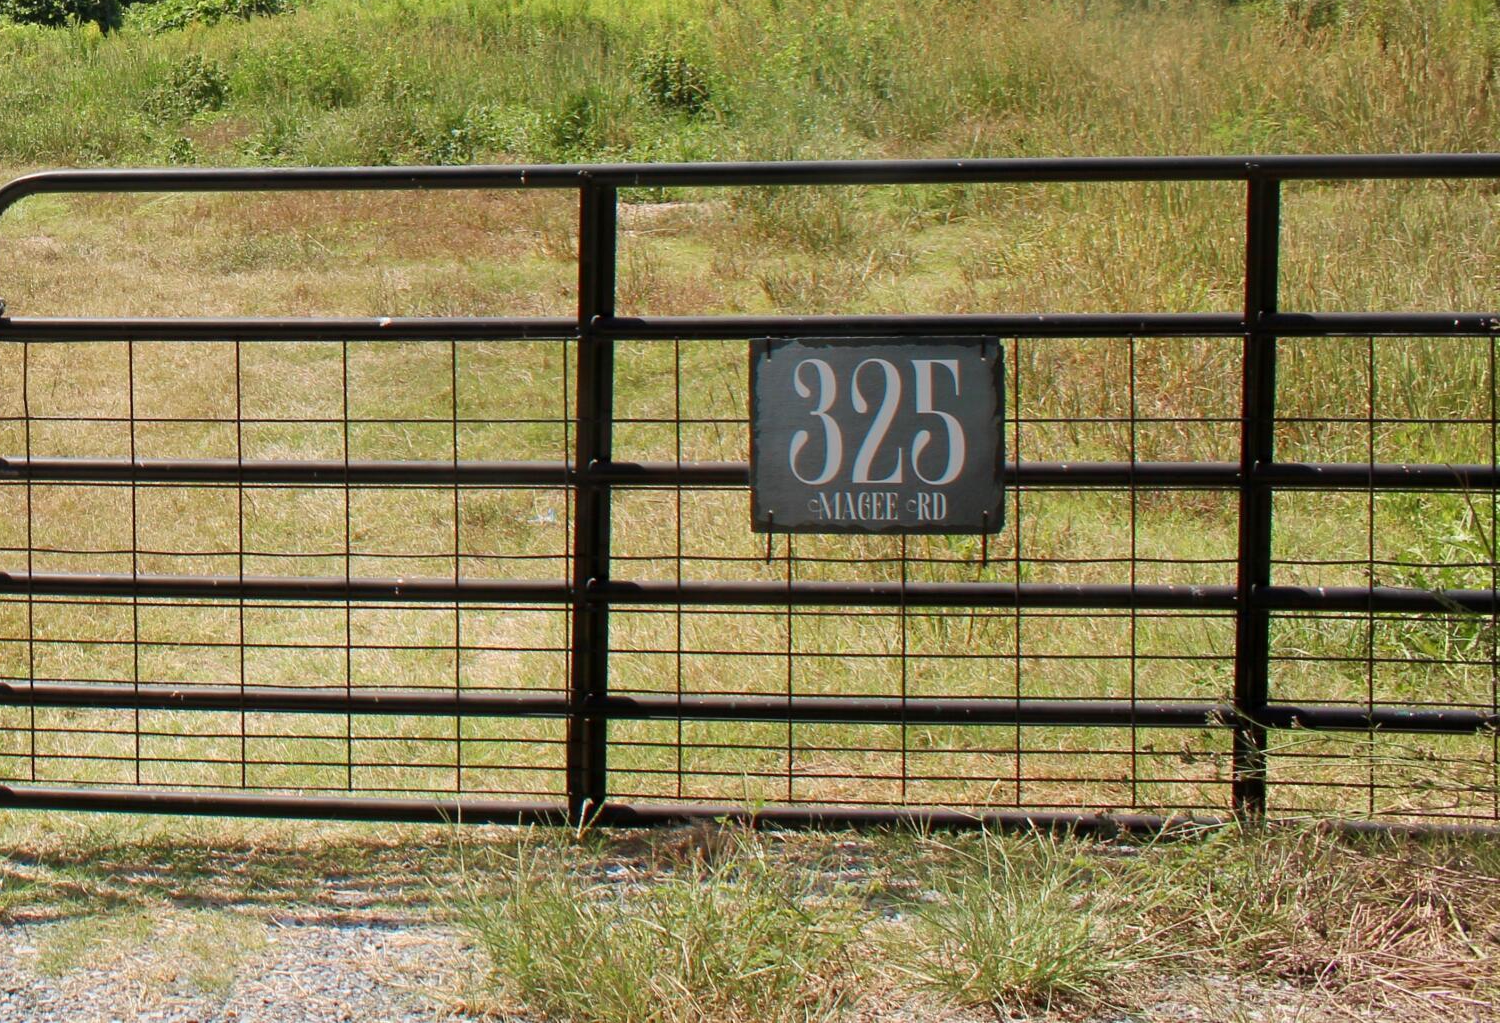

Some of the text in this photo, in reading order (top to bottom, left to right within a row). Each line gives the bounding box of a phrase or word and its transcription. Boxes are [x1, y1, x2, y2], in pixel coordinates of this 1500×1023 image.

[789, 358, 966, 486] 325
[807, 491, 947, 521] MAGEE RD
